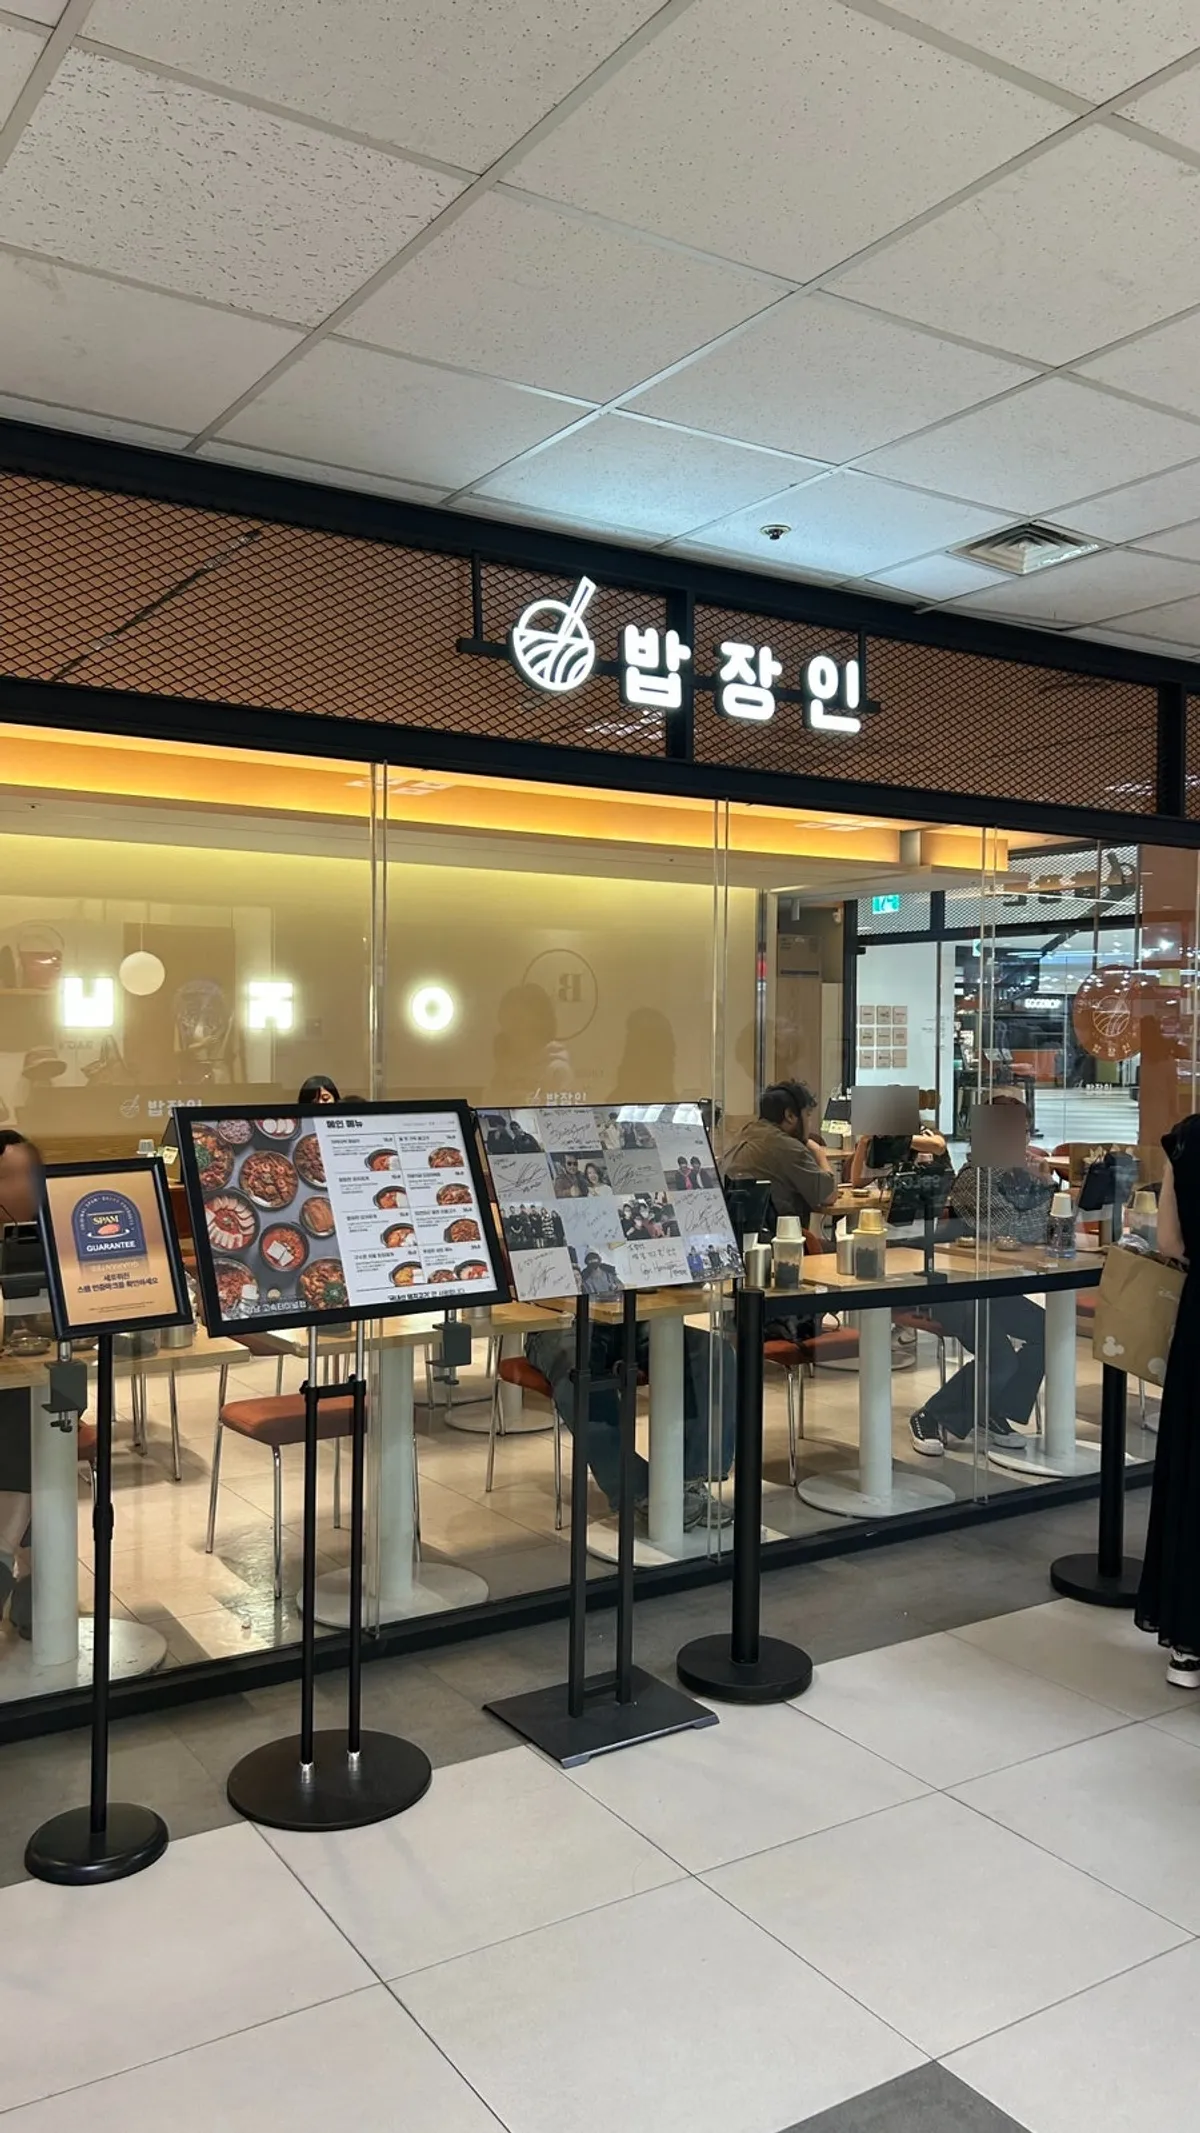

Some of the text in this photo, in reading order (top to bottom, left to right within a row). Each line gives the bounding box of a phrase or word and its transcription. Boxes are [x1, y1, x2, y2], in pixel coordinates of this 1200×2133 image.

[624, 624, 863, 733] 밥장인
[92, 1214, 120, 1226] SPAM
[86, 1240, 136, 1252] GUARANTEE
